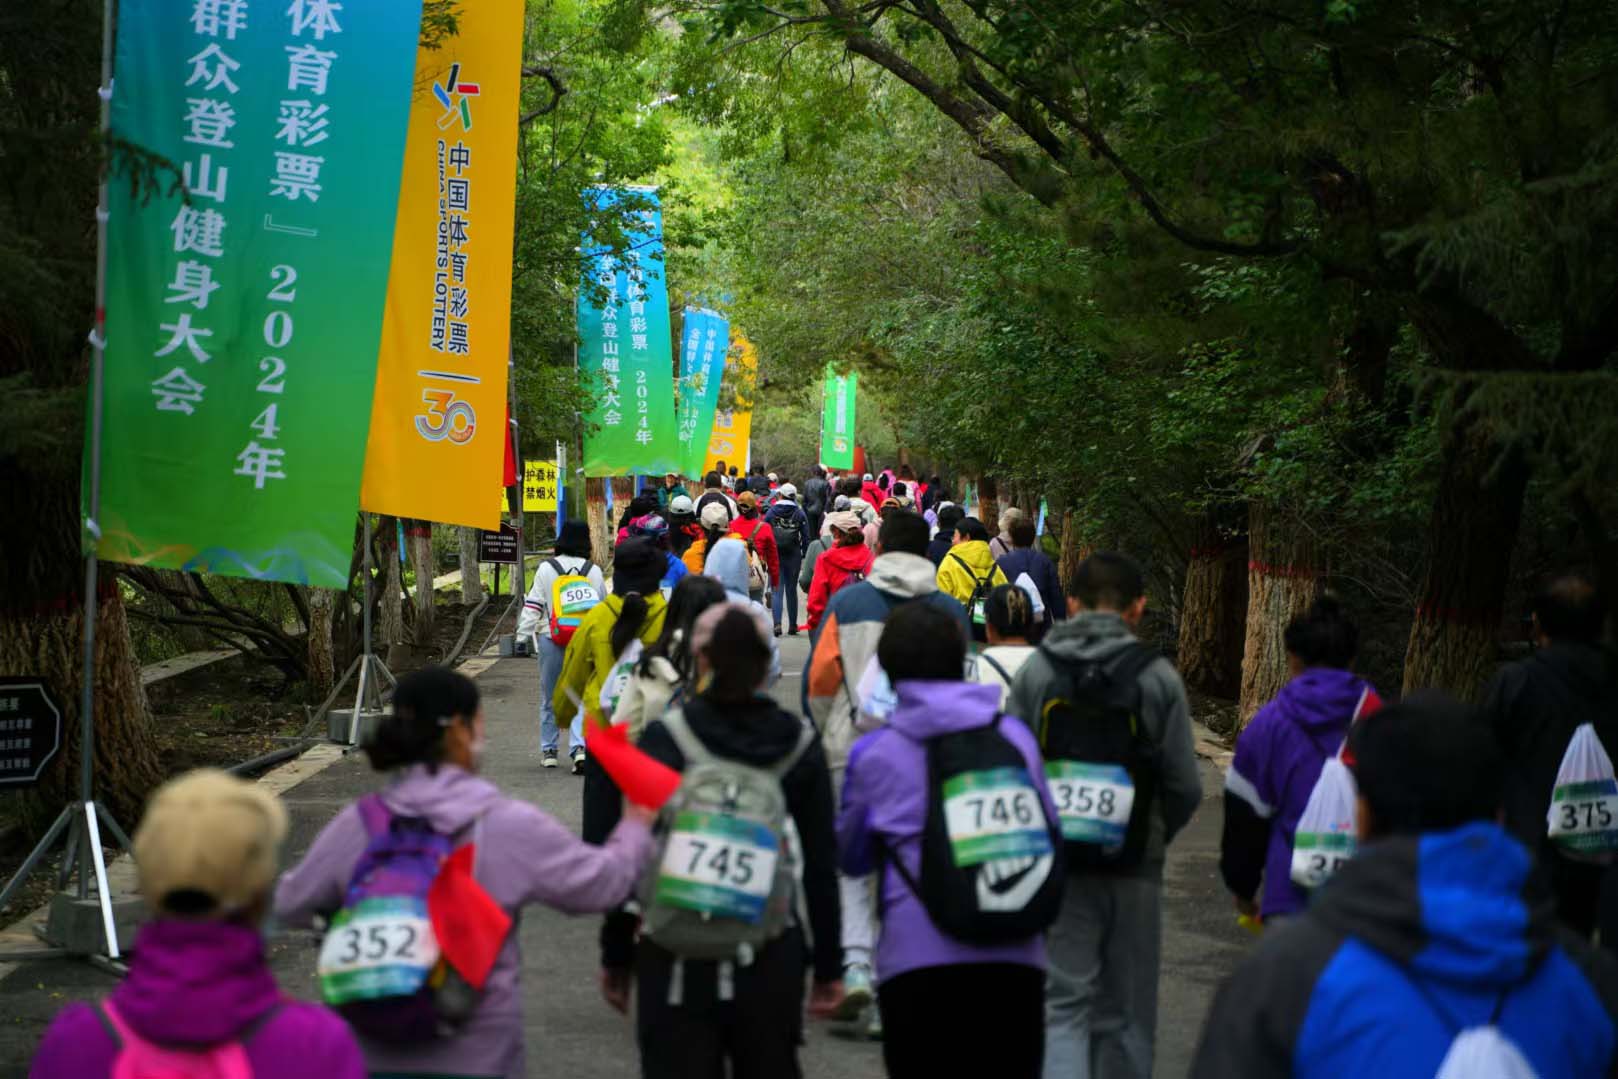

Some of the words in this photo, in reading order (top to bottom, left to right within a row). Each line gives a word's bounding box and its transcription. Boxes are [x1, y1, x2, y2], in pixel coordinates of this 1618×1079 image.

[152, 0, 248, 416] 群众登山健身大会
[447, 140, 470, 354] 中国体育彩票
[432, 271, 448, 351] LOTTERY
[566, 588, 593, 603] 505
[965, 793, 1032, 828] 746
[1057, 784, 1116, 817] 358
[1561, 801, 1612, 829] 375
[687, 841, 757, 885] 745
[338, 925, 417, 963] 352
